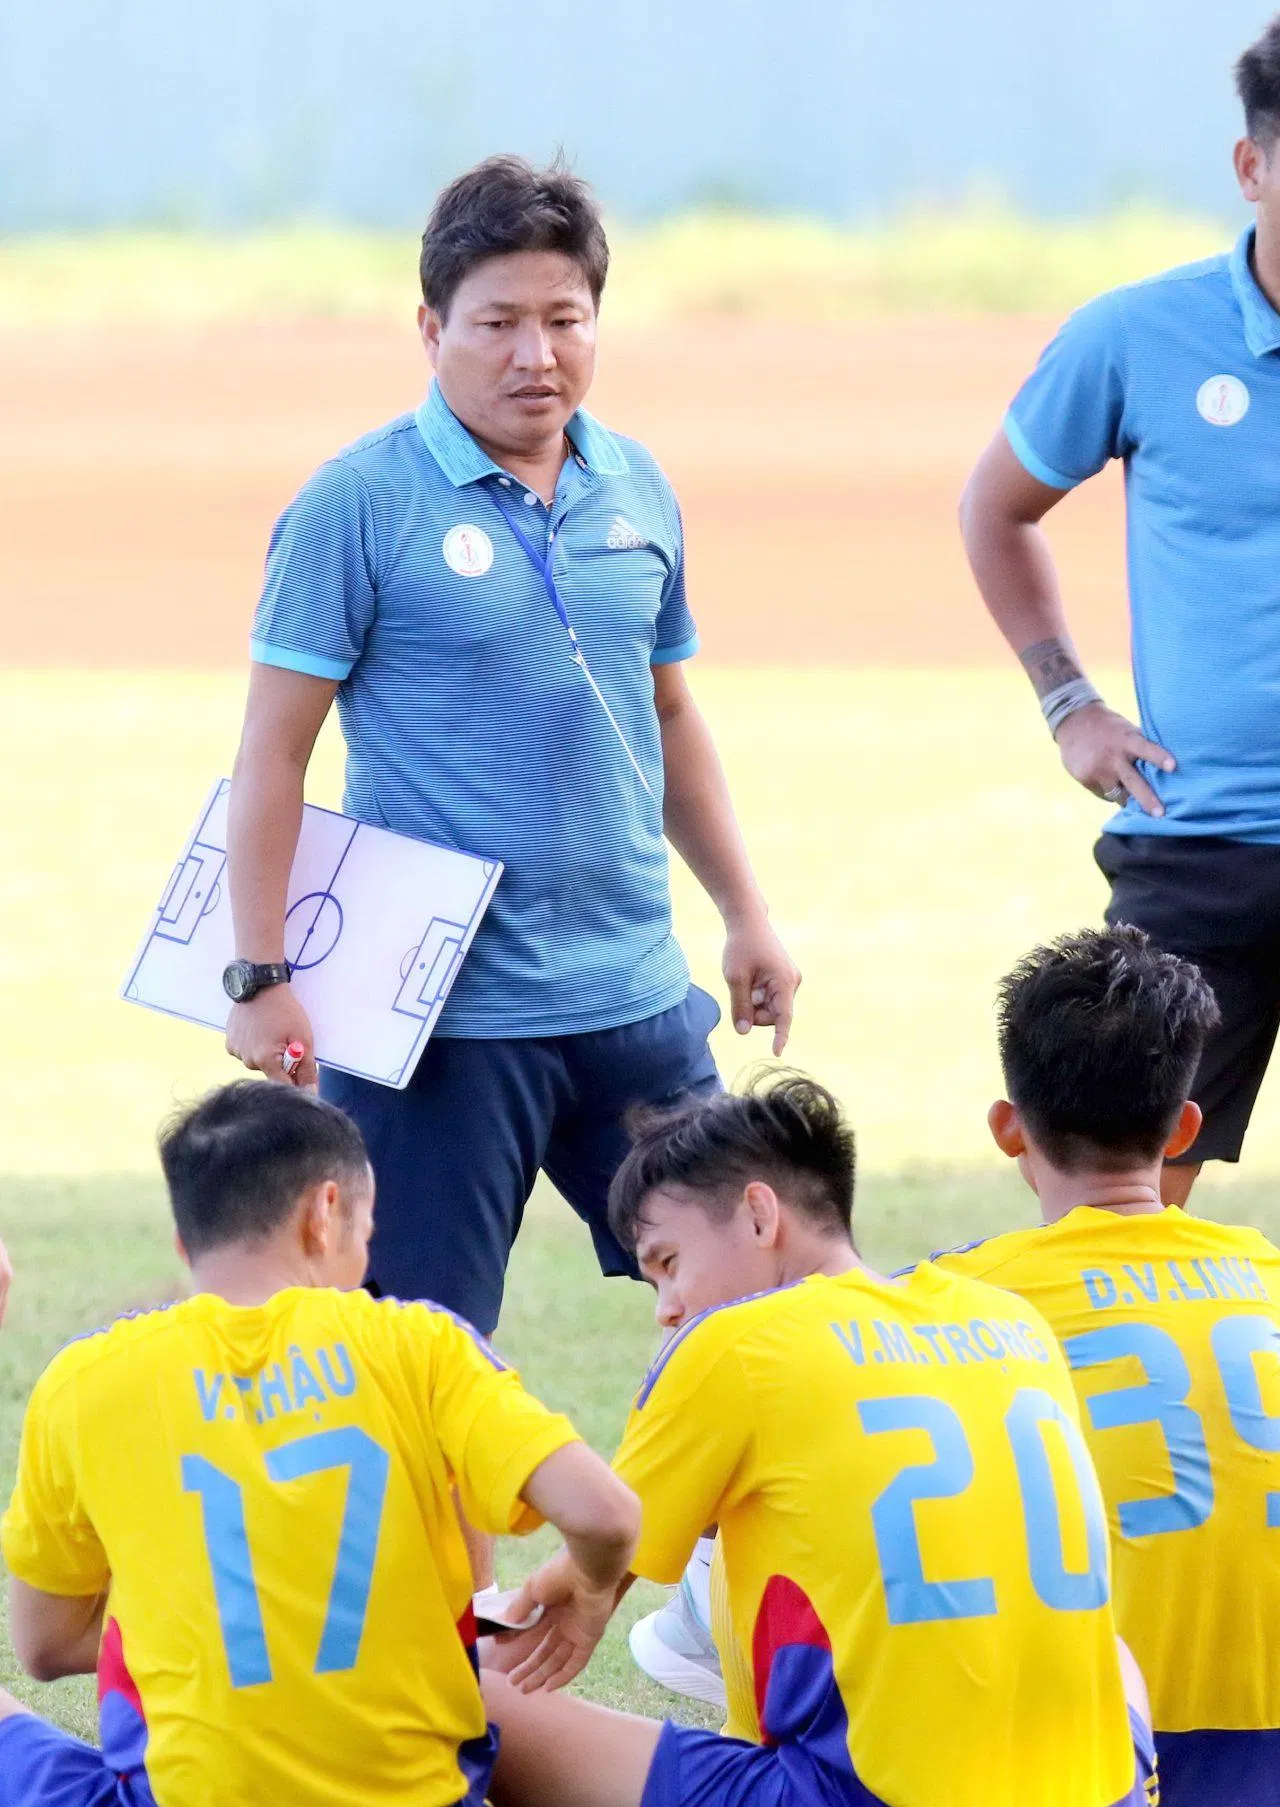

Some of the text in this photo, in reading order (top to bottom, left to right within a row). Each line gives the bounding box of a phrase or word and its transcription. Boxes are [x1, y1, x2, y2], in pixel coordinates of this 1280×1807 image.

[830, 1319, 1049, 1374] V.M.TRỌNG
[1081, 1257, 1269, 1309] D.V.LINH
[181, 1426, 389, 1688] 17
[856, 1387, 1109, 1625] 20
